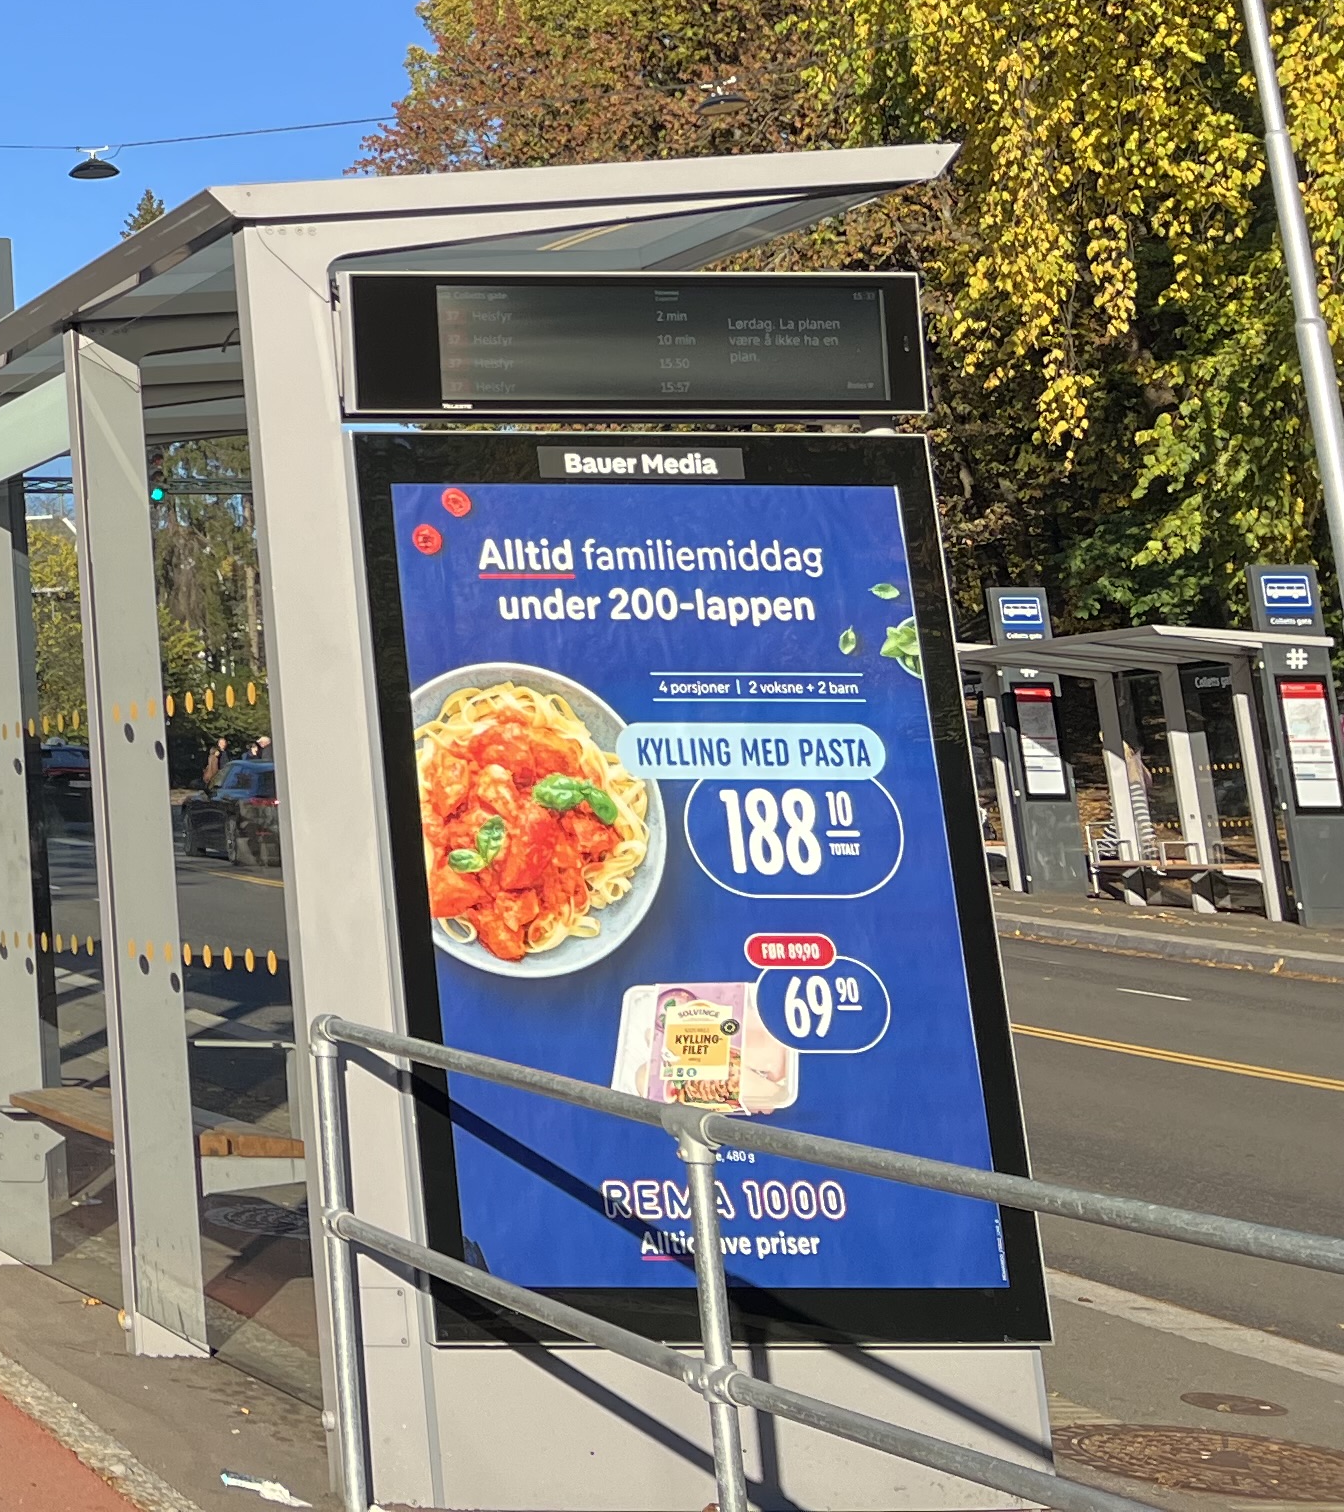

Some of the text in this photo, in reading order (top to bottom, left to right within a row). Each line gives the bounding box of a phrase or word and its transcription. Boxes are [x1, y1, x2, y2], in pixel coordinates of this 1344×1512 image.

[446, 310, 459, 321] 37
[656, 310, 664, 321] 2
[666, 310, 687, 321] min
[728, 318, 840, 332] Lørdag. La planen
[448, 334, 460, 345] 37
[657, 334, 672, 345] 10
[674, 334, 696, 345] min
[728, 335, 761, 346] være
[775, 334, 801, 346] ikke
[804, 334, 820, 346] ha
[823, 336, 839, 346] en
[730, 351, 760, 364] plan.
[564, 453, 718, 475] Bauer Media
[479, 538, 824, 577] Alltid familiemiddag
[498, 588, 816, 627] under 200-lappen
[659, 681, 668, 694] 4
[670, 681, 730, 696] porsjoner
[748, 681, 758, 694] 2
[761, 681, 803, 694] voksne
[817, 681, 827, 694] 2
[829, 681, 859, 695] barn
[636, 737, 872, 767] KYLLING MED PASTA
[719, 787, 853, 876] 188 10
[828, 842, 861, 856] TOTALT
[761, 942, 820, 962] FØR 89,90
[784, 975, 859, 1038] 69 90
[675, 1034, 724, 1045] KYLLING-
[682, 1044, 710, 1055] FILET
[726, 1149, 747, 1162] 480
[747, 1152, 755, 1164] g
[742, 1180, 847, 1220] 1000
[757, 1230, 821, 1260] priser
